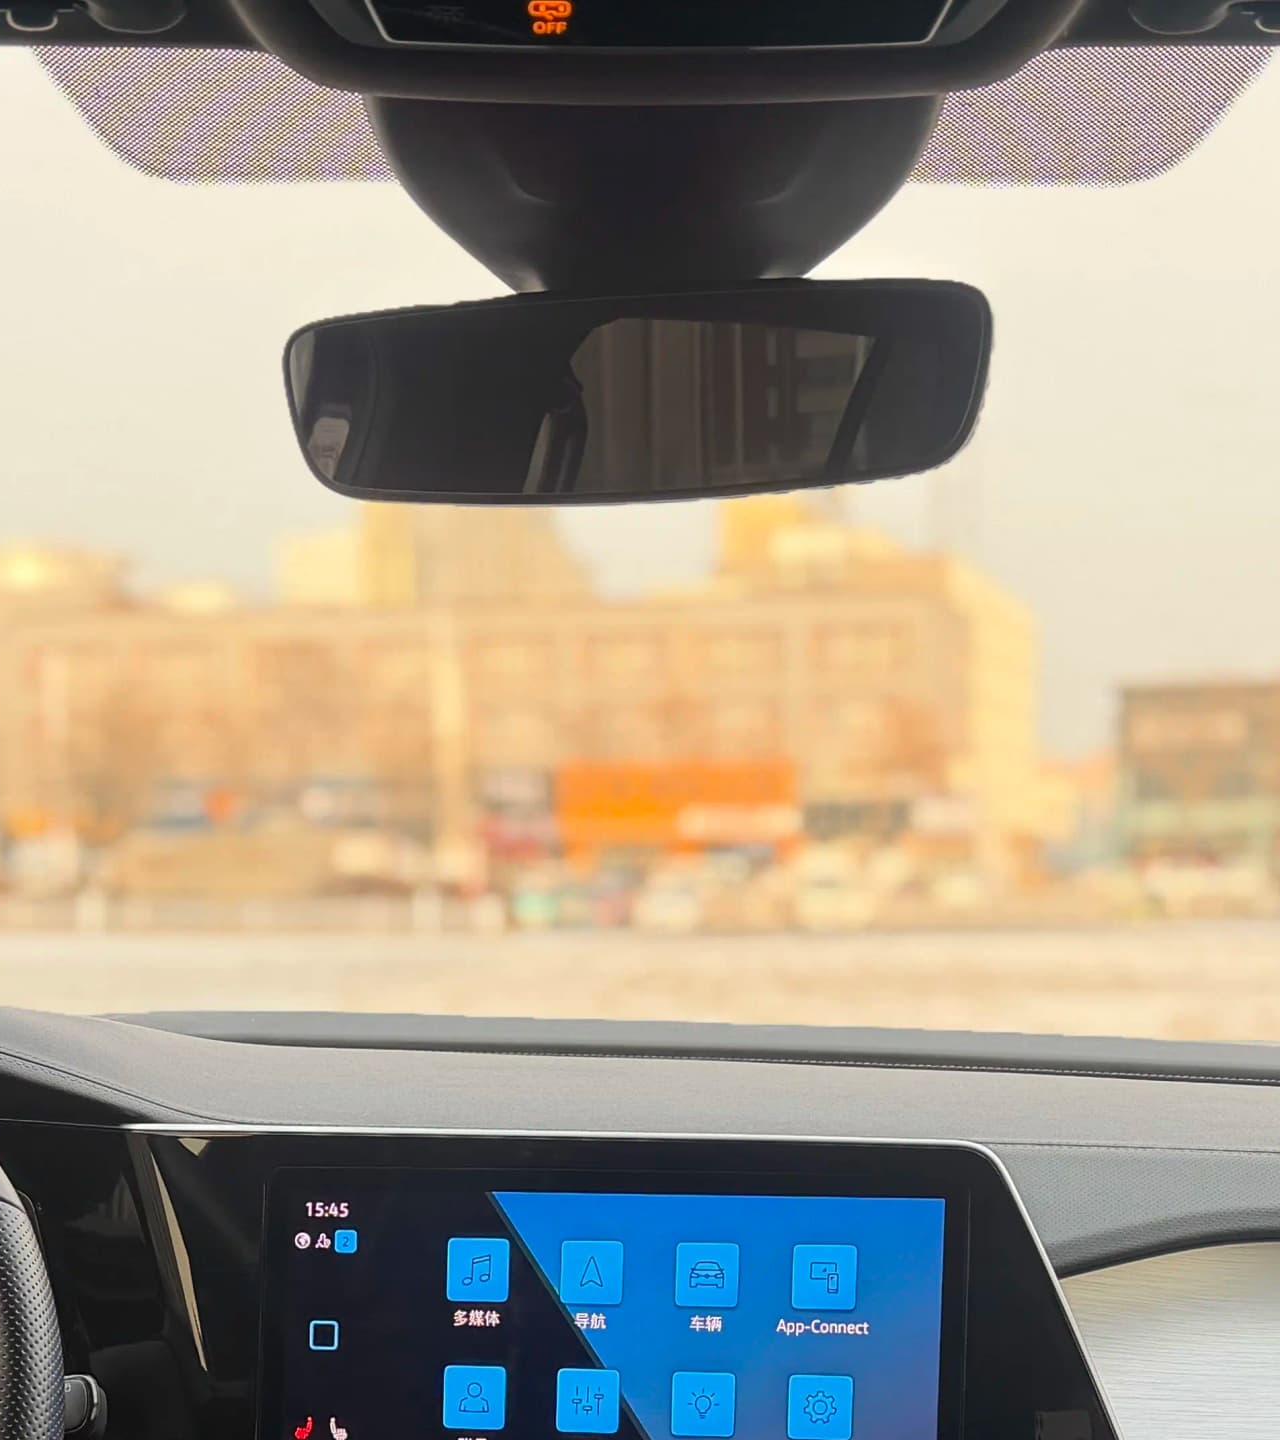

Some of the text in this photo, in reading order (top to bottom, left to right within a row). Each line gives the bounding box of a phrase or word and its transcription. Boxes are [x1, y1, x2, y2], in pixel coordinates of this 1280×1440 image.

[532, 21, 567, 34] OFF
[305, 1201, 349, 1218] 15:45
[342, 1236, 349, 1248] 2
[453, 1309, 501, 1328] 多媒体
[573, 1312, 607, 1330] 导航
[689, 1316, 723, 1333] 车辆
[776, 1319, 870, 1336] App-Connect
